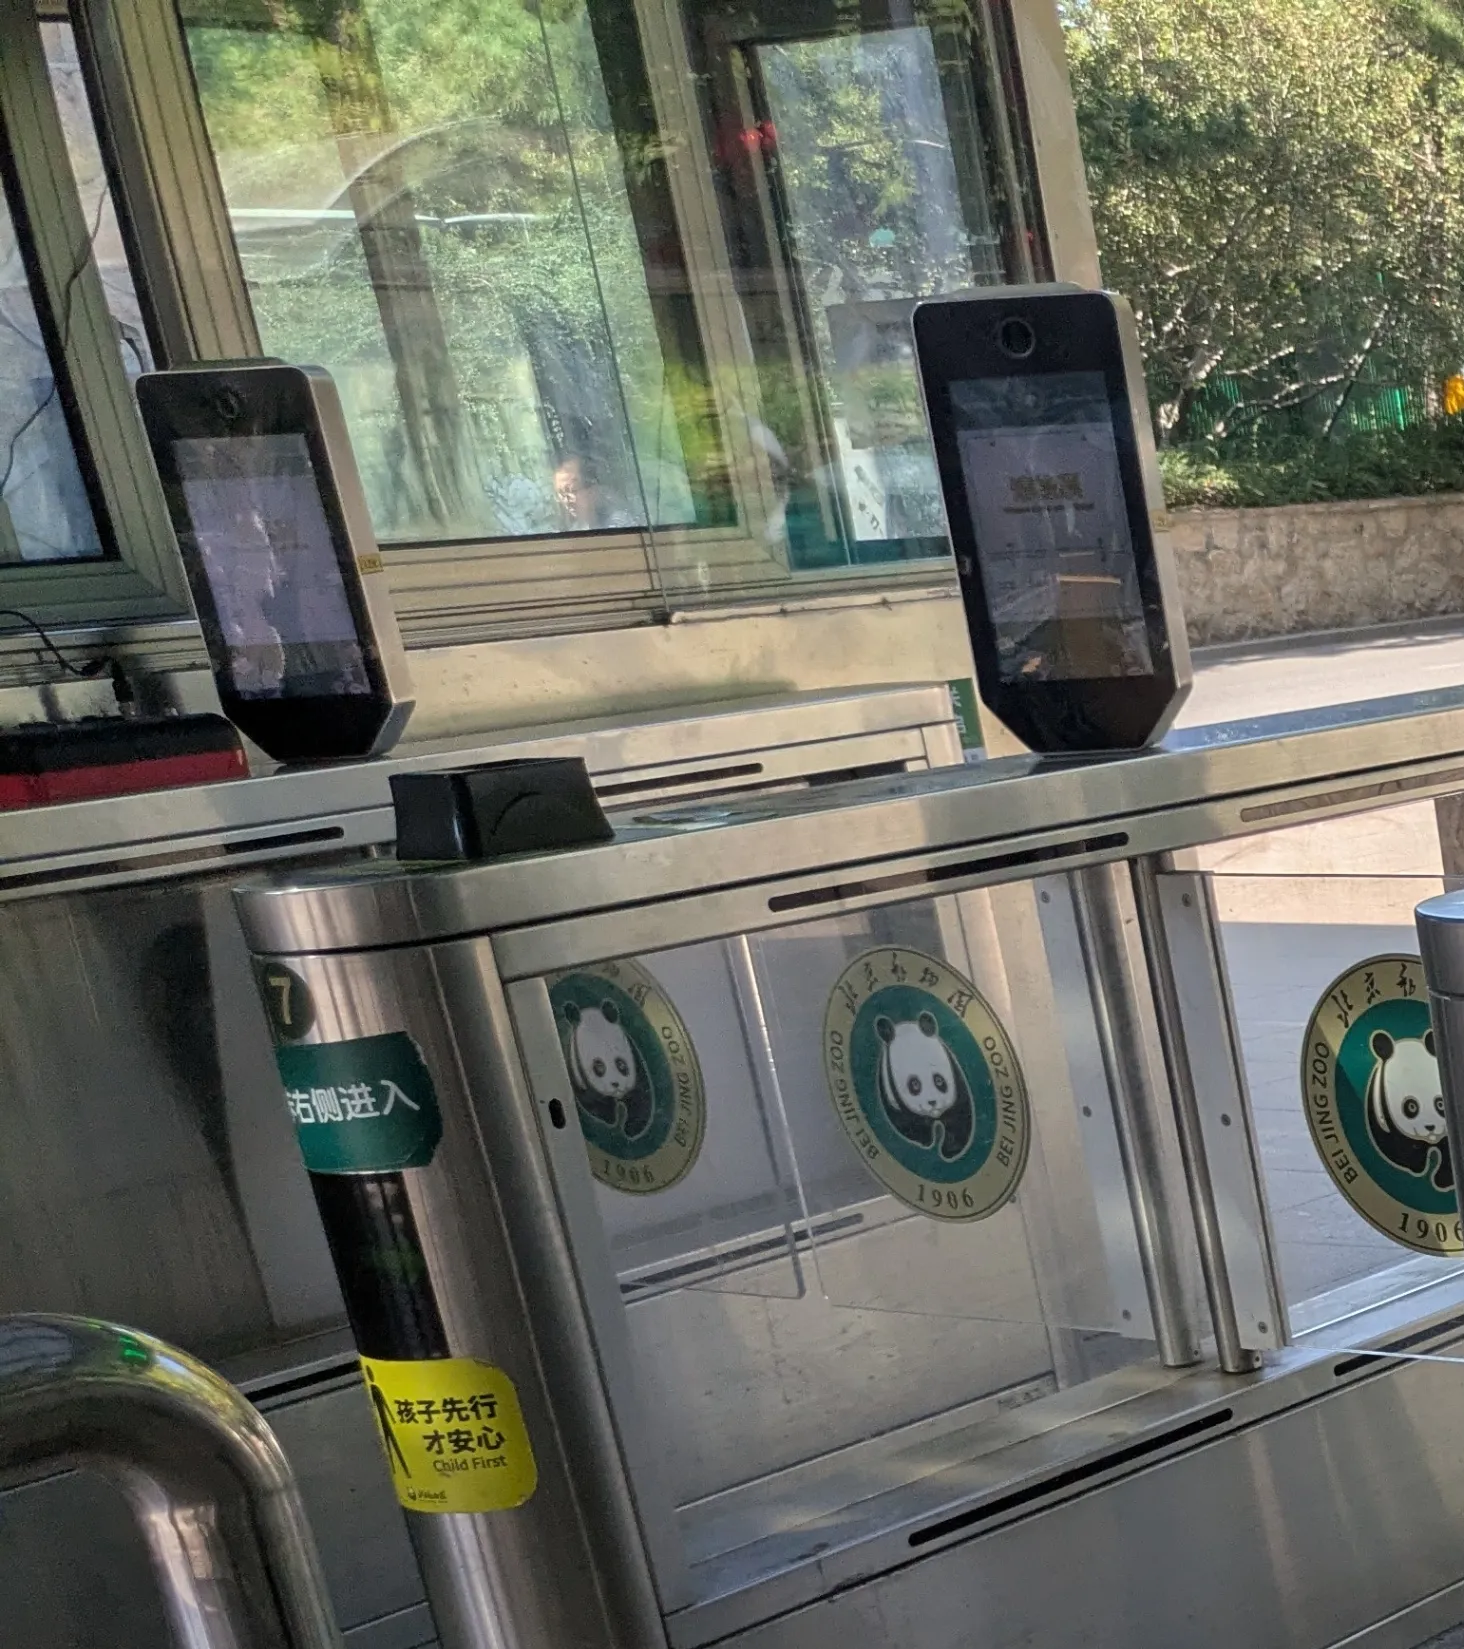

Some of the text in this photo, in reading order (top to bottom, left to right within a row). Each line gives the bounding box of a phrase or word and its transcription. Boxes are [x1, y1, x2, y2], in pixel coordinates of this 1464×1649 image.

[268, 977, 292, 1025] 7
[918, 1184, 974, 1210] 1906
[394, 1393, 498, 1424] 孩子先行
[423, 1426, 506, 1454] 才安心
[433, 1455, 508, 1473] Child First
